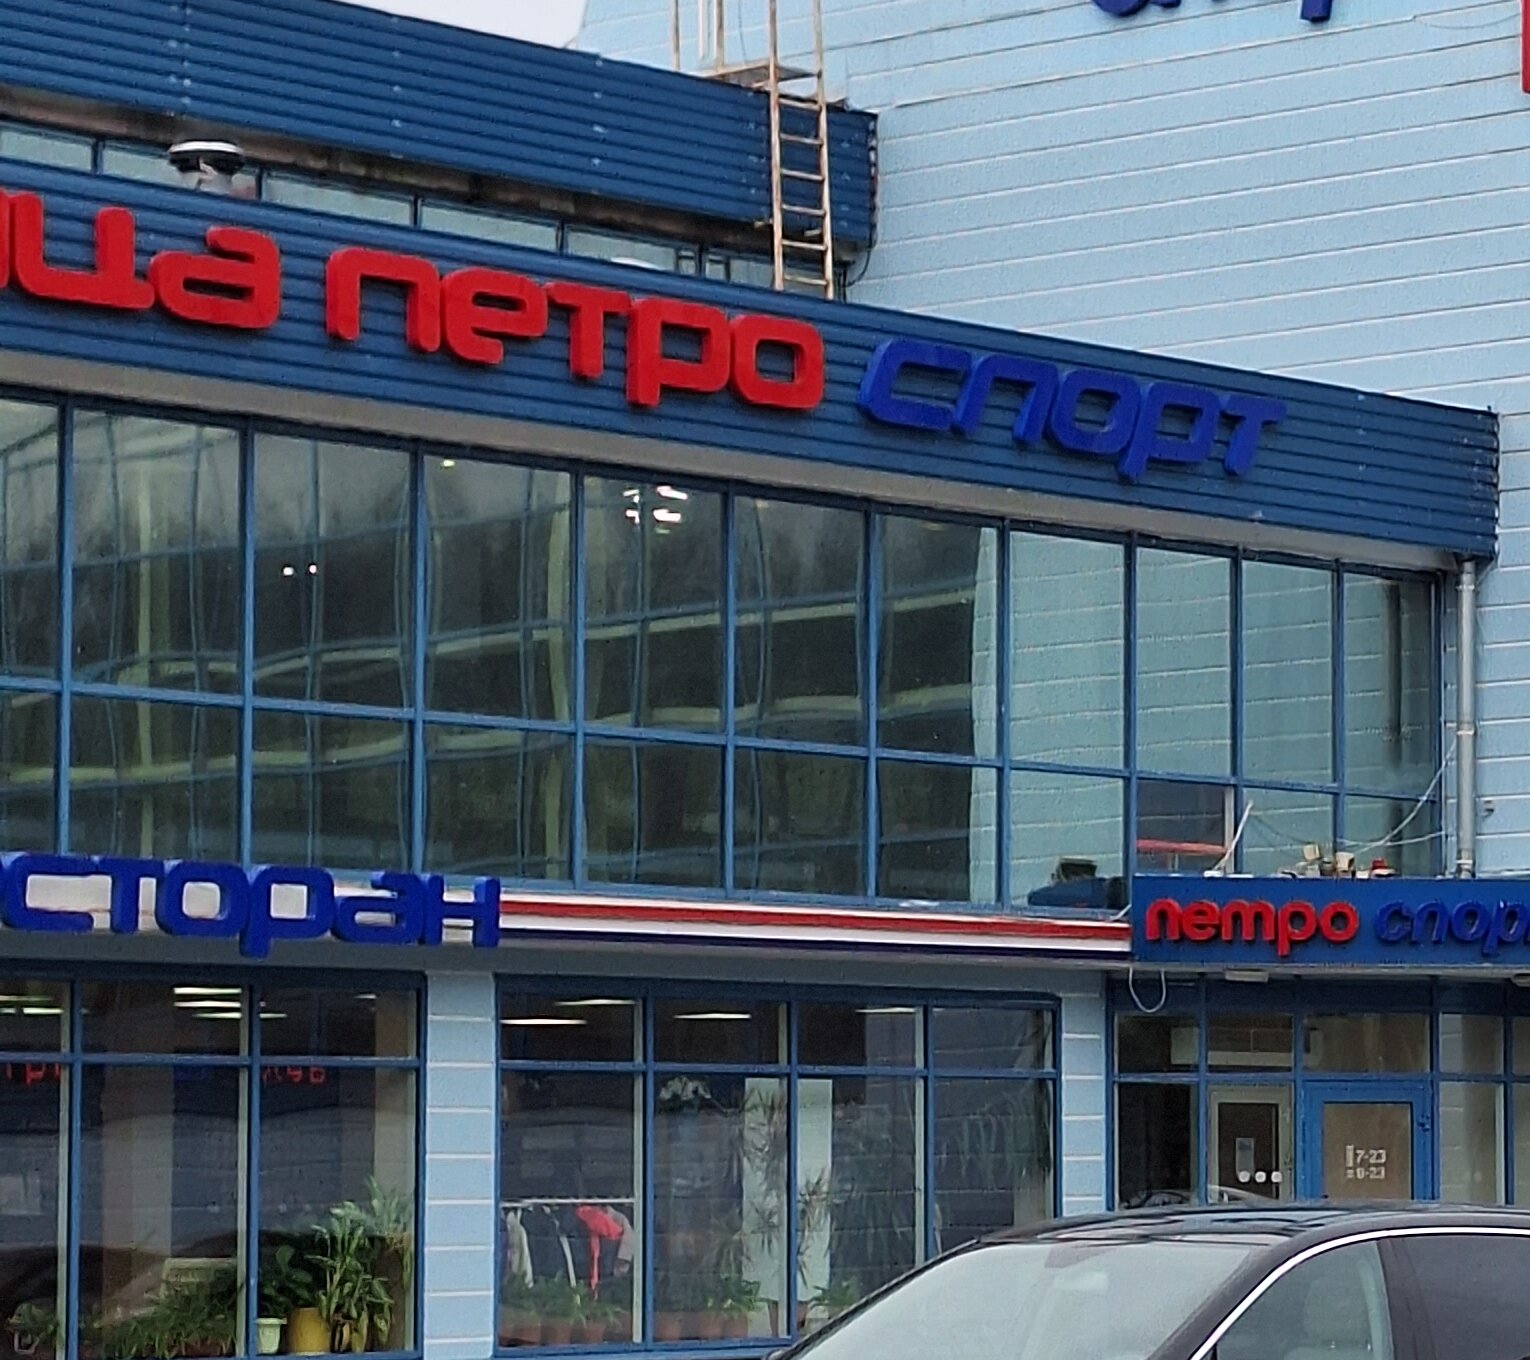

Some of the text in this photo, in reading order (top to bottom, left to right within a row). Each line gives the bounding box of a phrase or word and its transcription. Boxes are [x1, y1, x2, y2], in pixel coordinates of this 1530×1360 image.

[325, 246, 825, 411] петро
[856, 337, 1288, 482] спорт
[1145, 898, 1360, 957] петро
